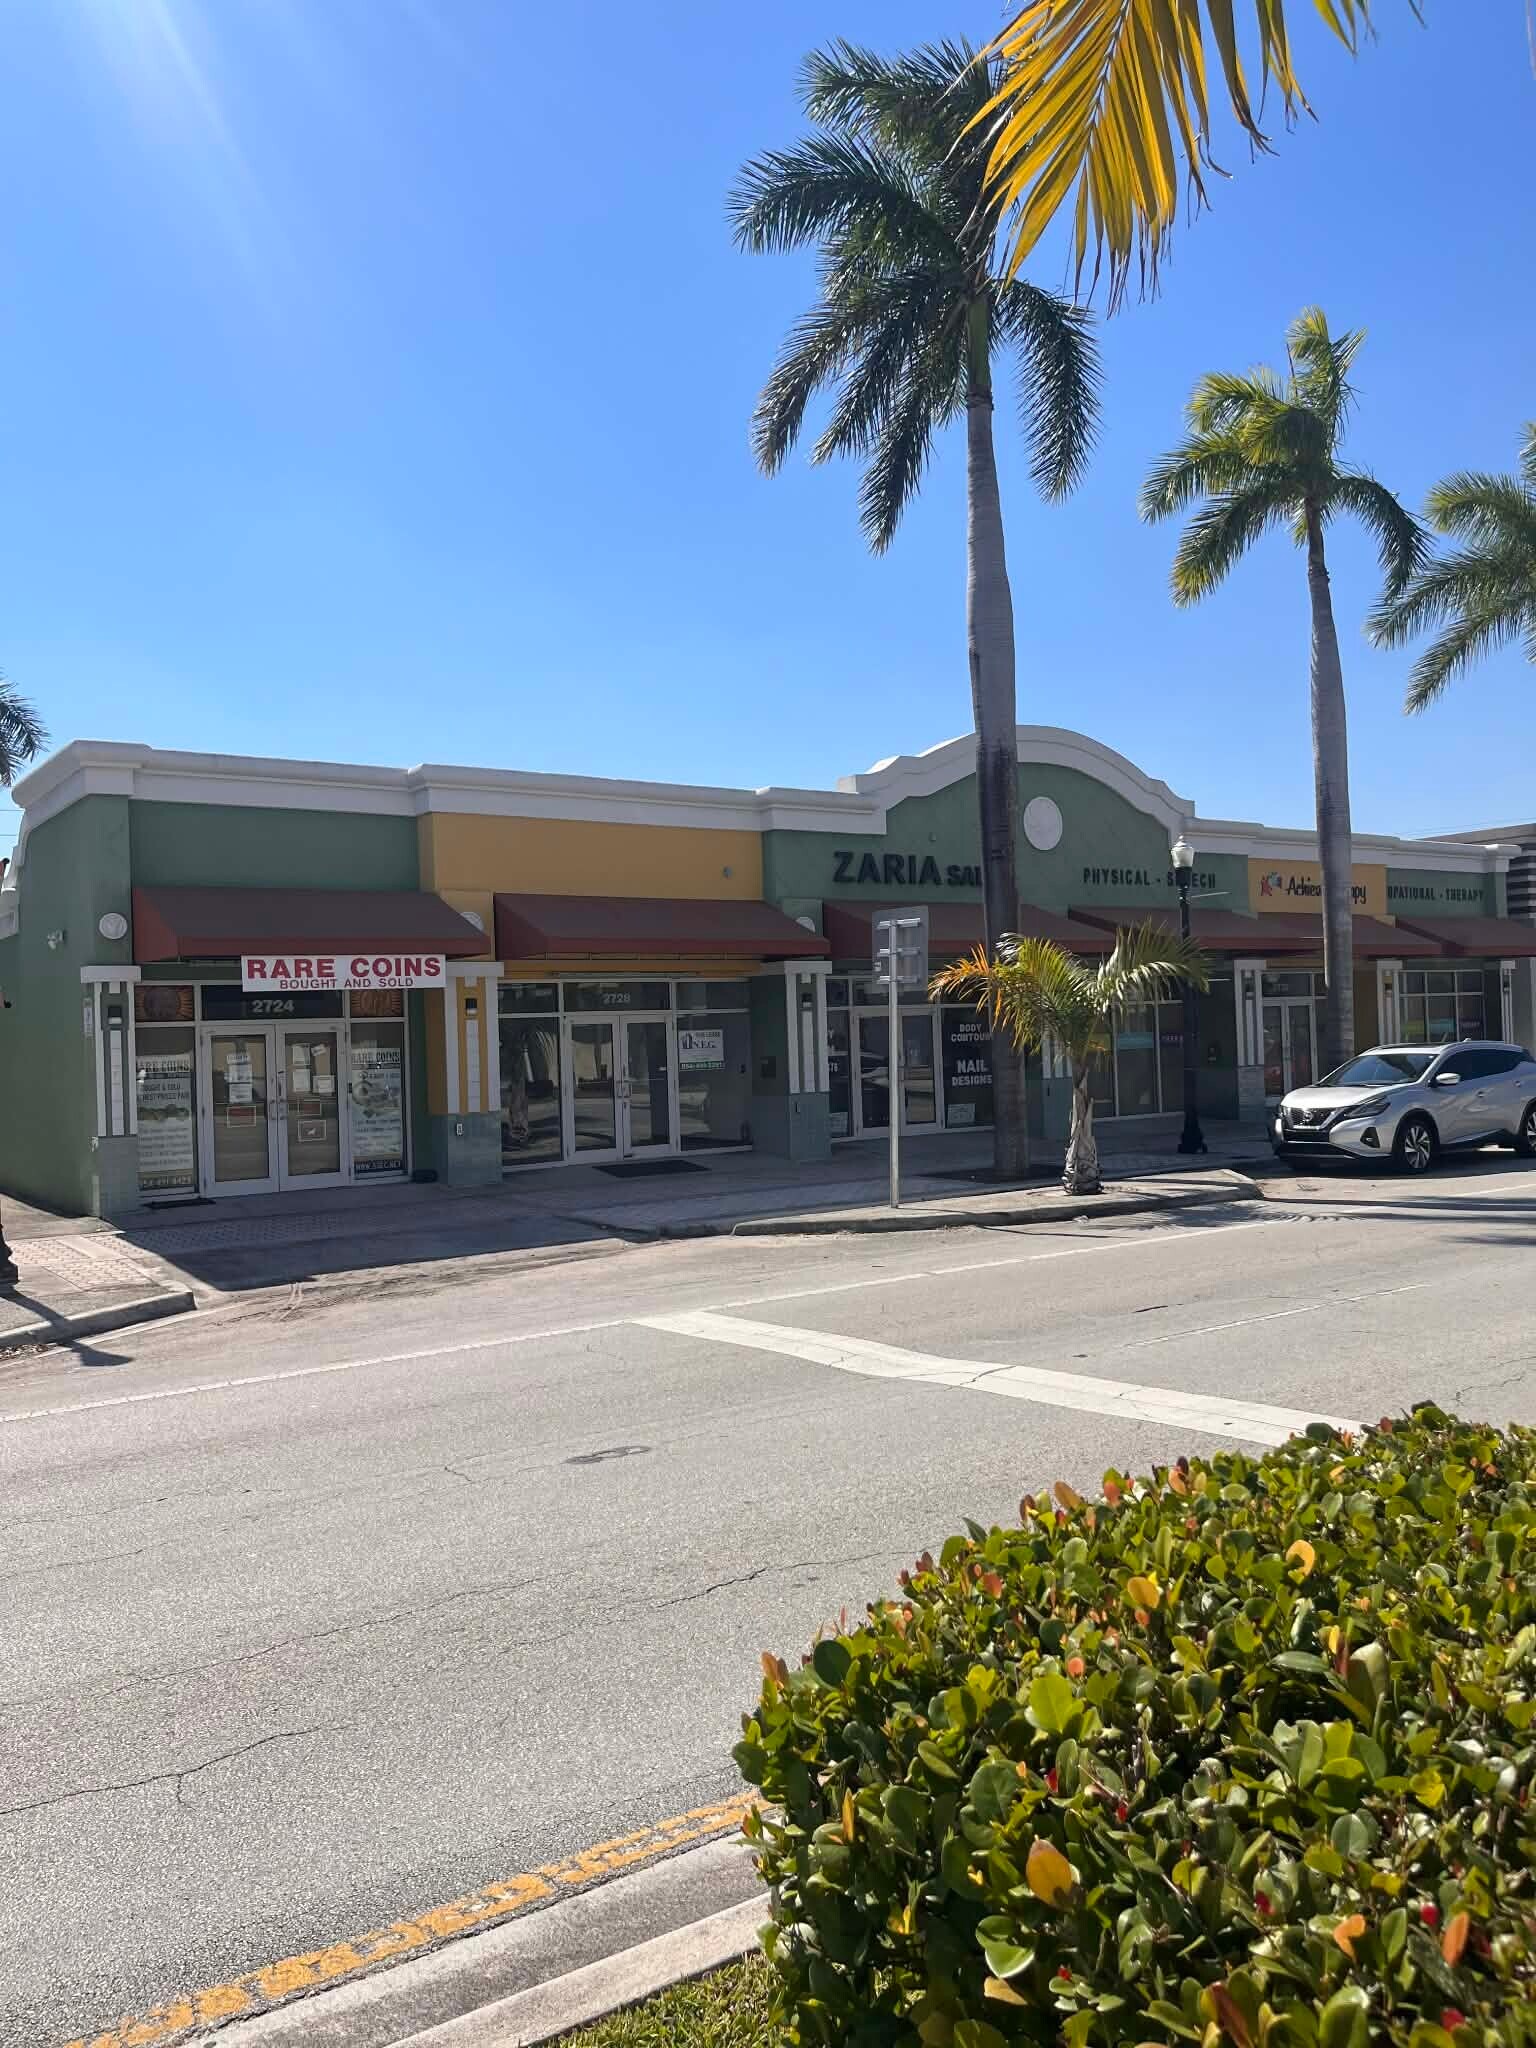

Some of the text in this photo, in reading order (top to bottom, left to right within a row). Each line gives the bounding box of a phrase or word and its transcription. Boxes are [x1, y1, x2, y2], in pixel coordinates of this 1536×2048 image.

[833, 850, 983, 887] ZARIA SAL
[1082, 867, 1151, 886] PHYSICAL
[1167, 870, 1216, 888] SECH
[1286, 876, 1322, 897] Achiev
[1446, 888, 1484, 902] THERAPY
[247, 957, 441, 979] RARE COINS
[279, 977, 414, 990] BOUGHT AND SOLD
[602, 992, 631, 1005] 2728
[252, 999, 295, 1013] 2724
[959, 1023, 982, 1033] BODY
[957, 1059, 989, 1073] NAIL
[951, 1074, 993, 1086] DESIGNS
